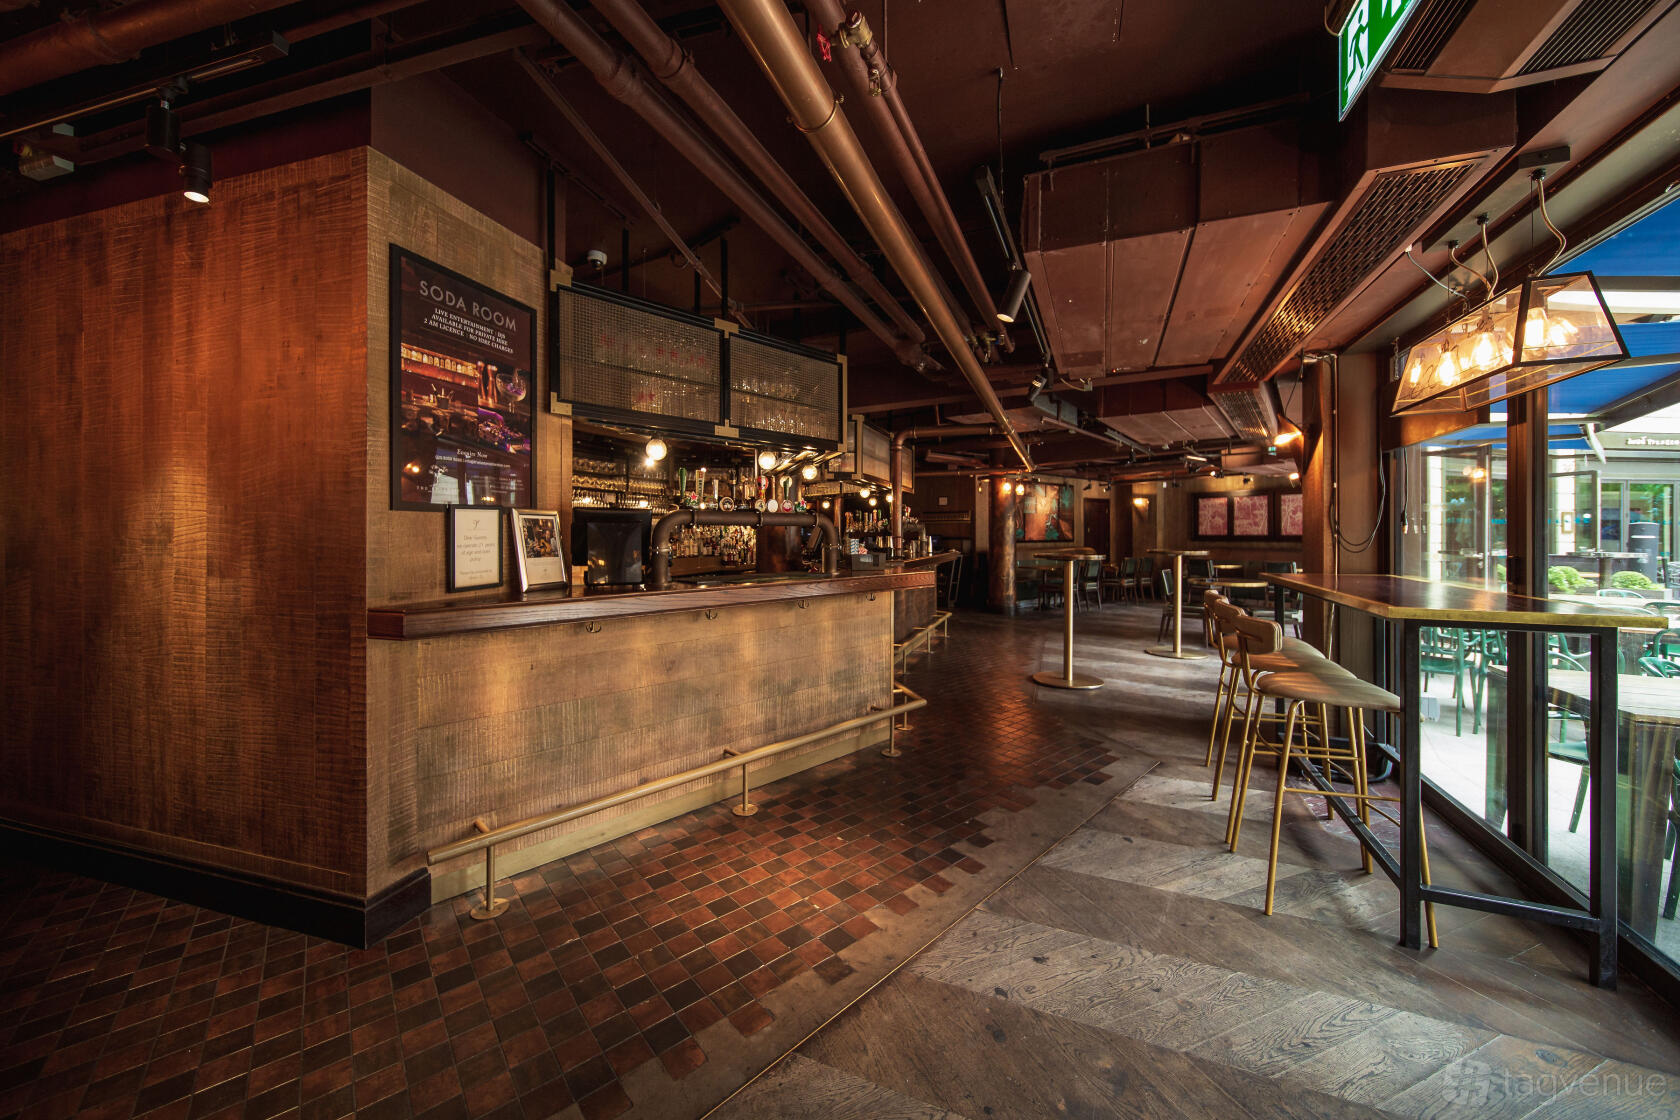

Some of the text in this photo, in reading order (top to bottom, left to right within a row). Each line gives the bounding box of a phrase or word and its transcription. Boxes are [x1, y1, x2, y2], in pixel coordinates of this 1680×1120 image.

[420, 280, 516, 332] SODA ROOM
[434, 307, 449, 318] LIVE
[449, 313, 494, 334] ENTERTAINMENT
[429, 319, 438, 328] AM
[439, 322, 464, 337] LICENCE
[491, 342, 514, 354] CHARGES
[431, 314, 463, 330] AVAILABLE
[463, 324, 474, 334] FOR
[475, 329, 496, 342] PRIVATE
